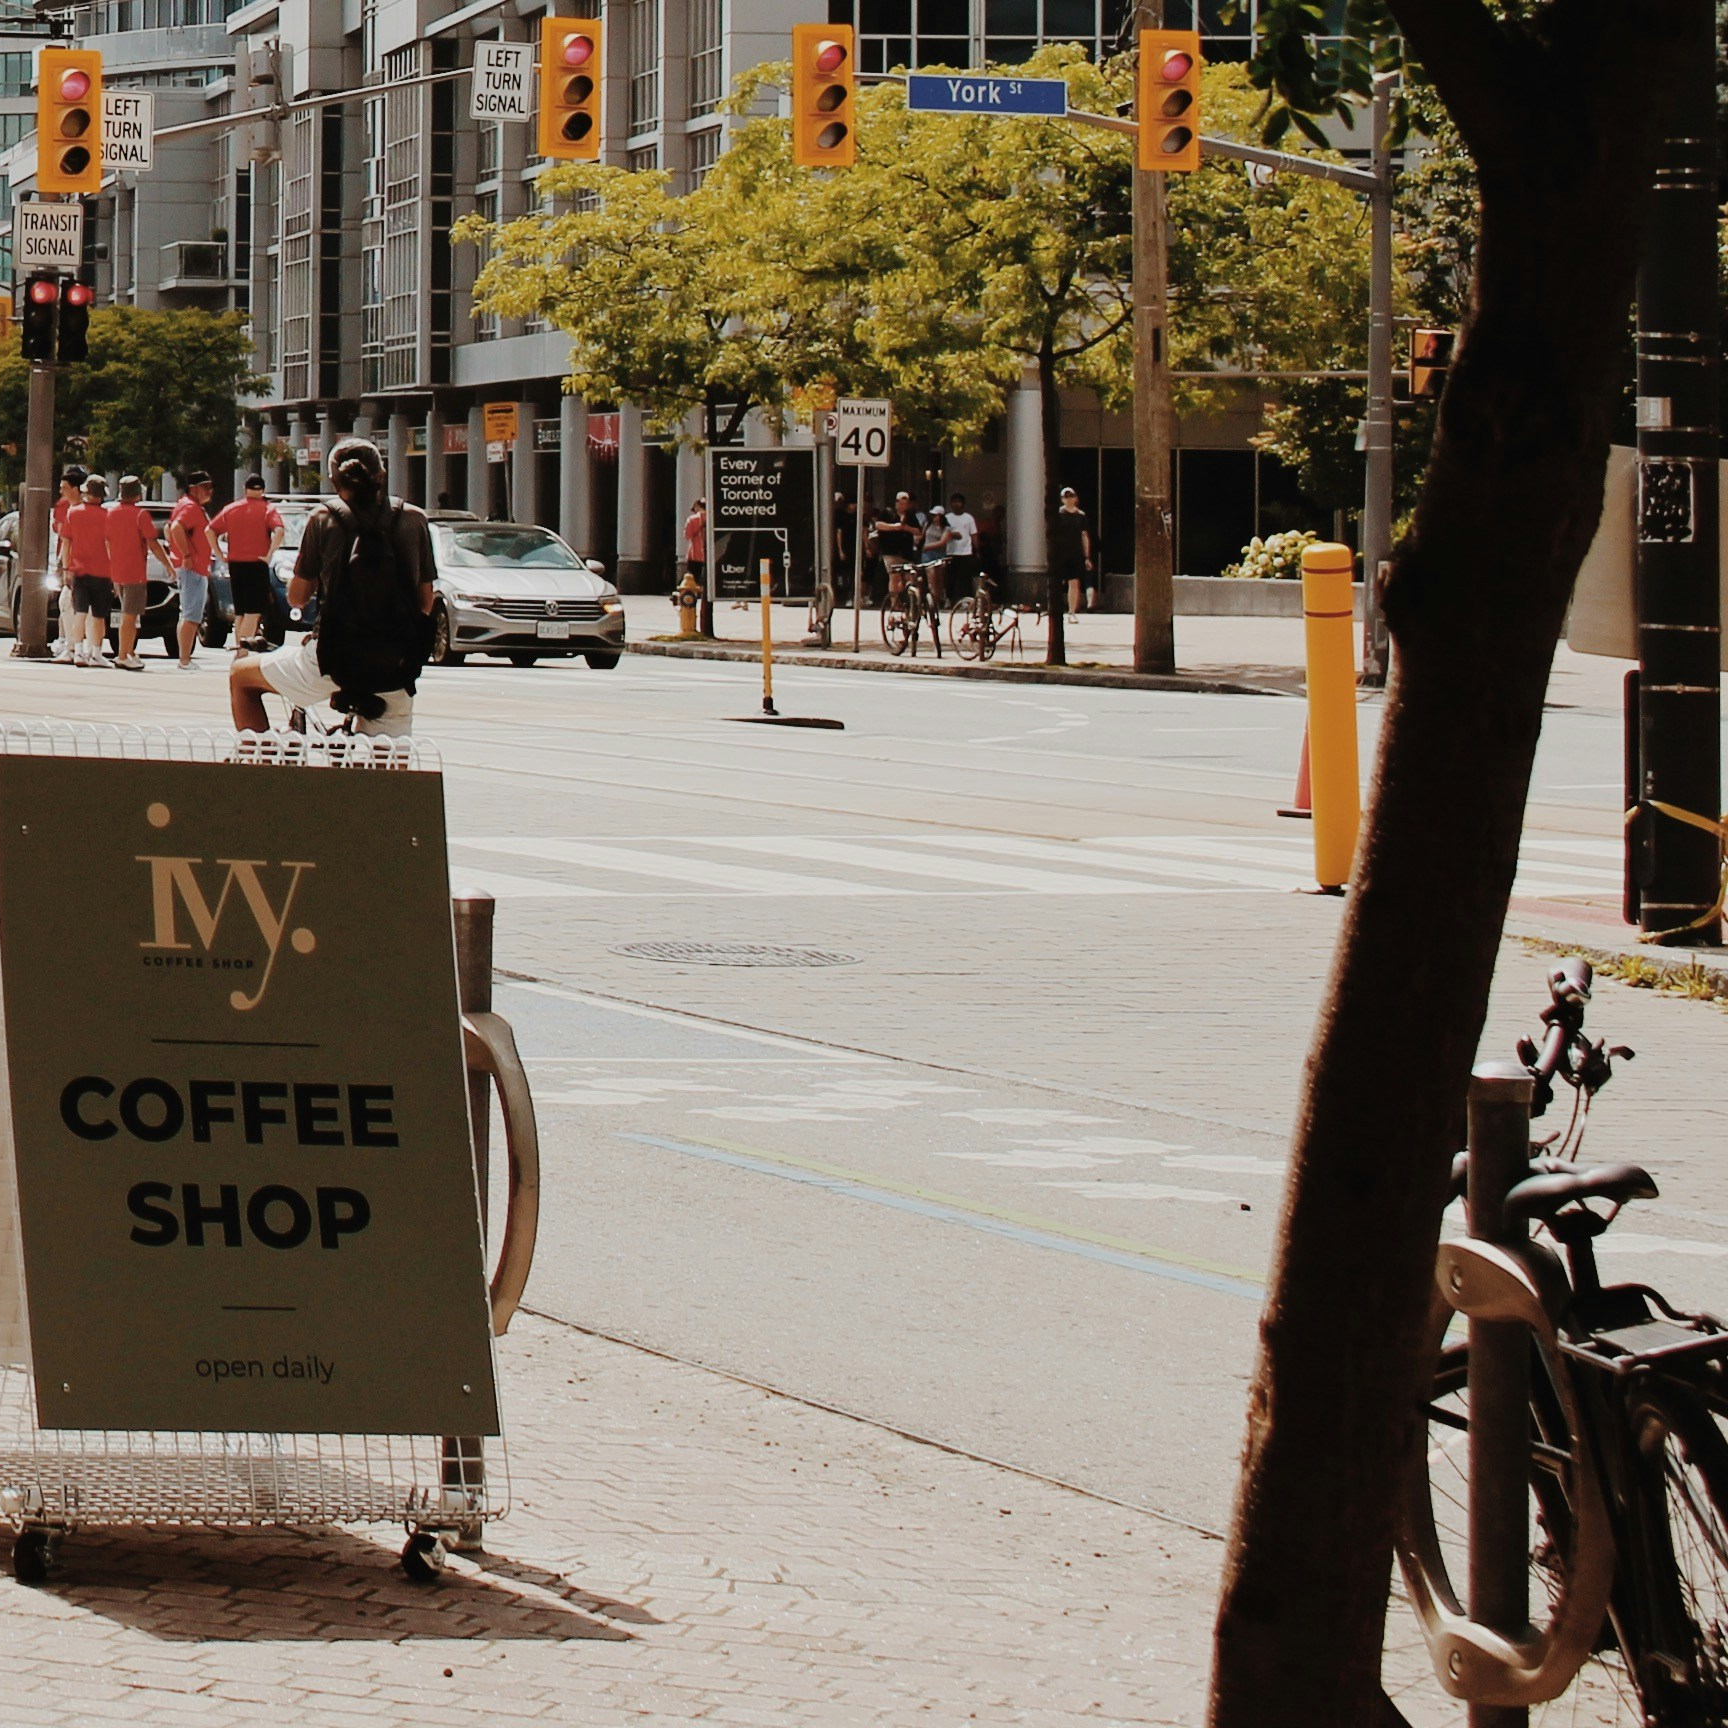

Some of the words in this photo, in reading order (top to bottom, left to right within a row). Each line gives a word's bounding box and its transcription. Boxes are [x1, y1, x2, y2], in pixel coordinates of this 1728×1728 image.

[487, 50, 521, 68] LEFT
[485, 72, 521, 90] TURN
[947, 79, 1001, 104] York
[1009, 82, 1022, 94] St
[105, 98, 140, 116] LEFT
[476, 93, 525, 113] SIGNAL
[104, 121, 142, 139] TURN
[23, 213, 79, 231] TRANSIT
[26, 237, 75, 256] SIGNAL
[842, 406, 886, 417] MAXIMUM
[841, 427, 886, 457] 40
[720, 457, 757, 472] Every
[720, 474, 764, 485] corner
[767, 473, 782, 485] of
[721, 488, 773, 500] Toronto
[721, 503, 777, 516] covered
[721, 564, 745, 574] Uber
[143, 955, 205, 969] COFFEE
[211, 957, 255, 970] SHOP
[59, 1075, 400, 1148] COFFEE
[126, 1180, 372, 1250] SHOP
[195, 1357, 264, 1383] open
[272, 1355, 335, 1385] daily
